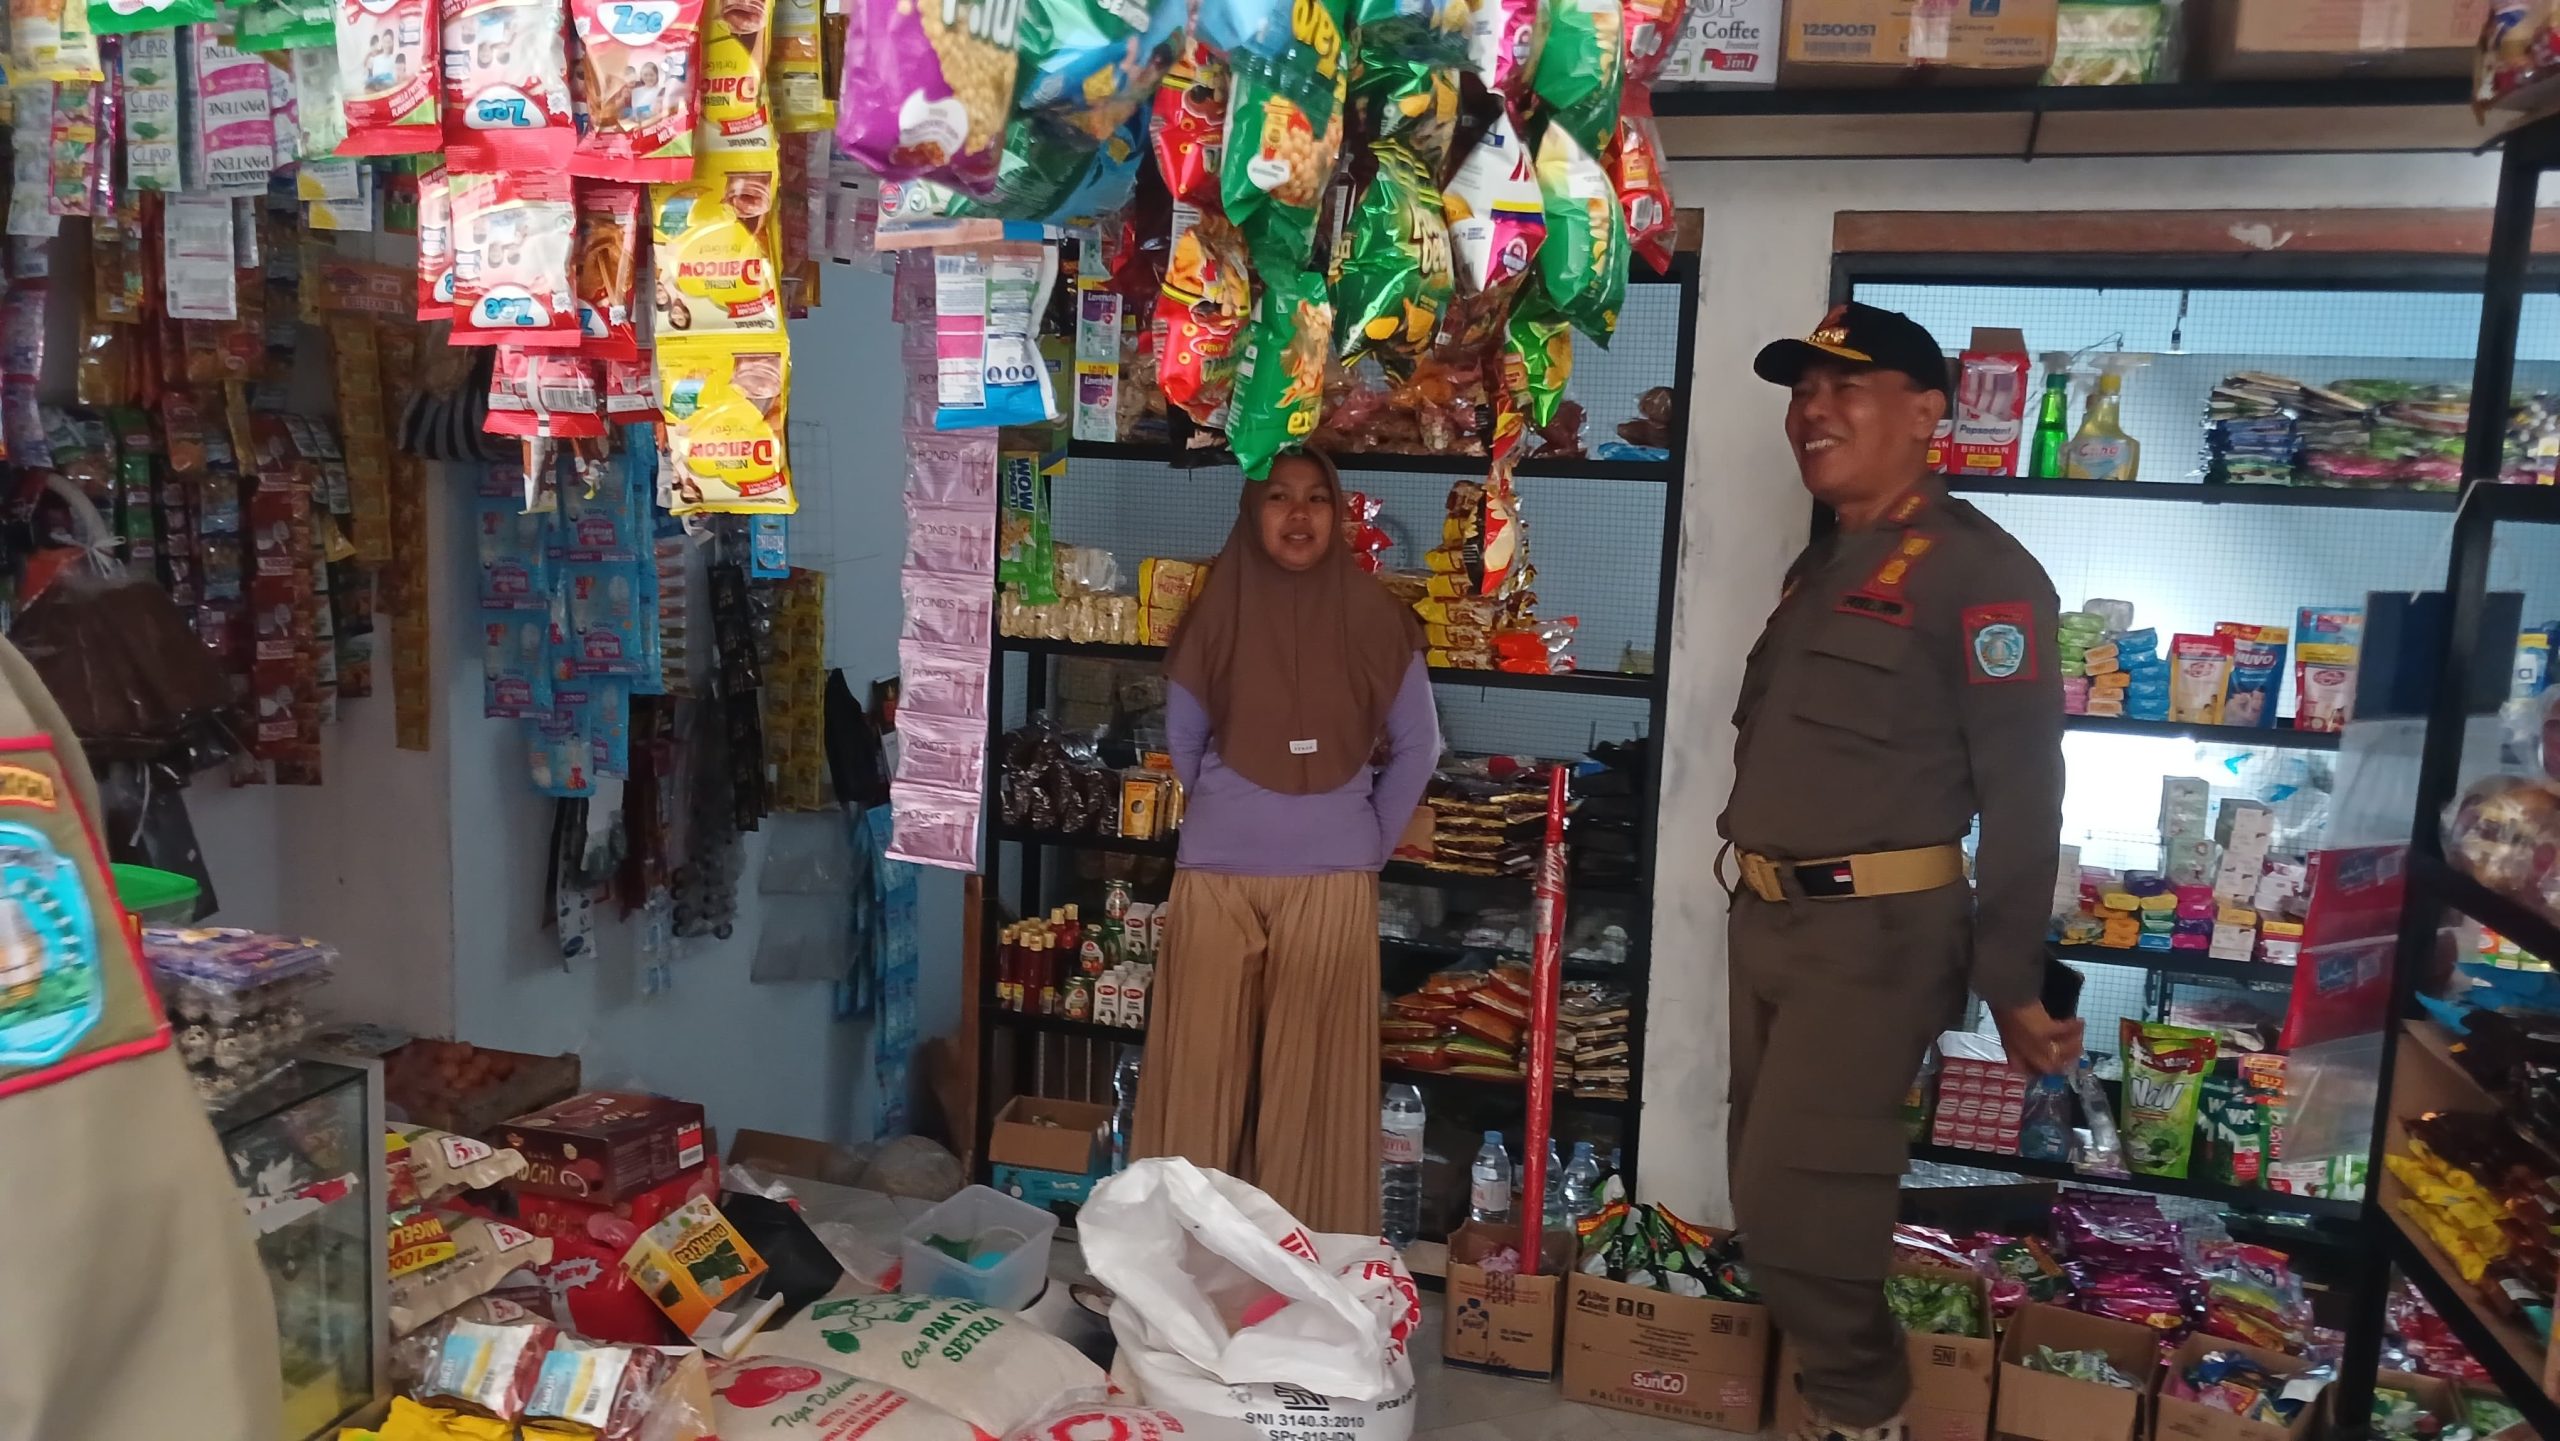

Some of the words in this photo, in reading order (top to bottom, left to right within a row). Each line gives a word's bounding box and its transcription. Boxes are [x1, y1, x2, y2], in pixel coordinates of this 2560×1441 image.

[612, 5, 664, 35] Zee
[1702, 20, 1760, 39] Coffee
[1803, 23, 1877, 37] 1250051
[128, 38, 168, 54] CLEAR
[131, 91, 169, 109] CLEAR
[208, 99, 267, 115] PANTENE
[476, 98, 531, 127] Zee
[132, 145, 172, 163] CLEAR
[211, 154, 272, 171] PANTENE
[678, 259, 761, 286] Dancow
[484, 297, 535, 326] Zee
[688, 439, 773, 466] Dancow
[1960, 446, 2009, 455] BRILIAN
[1016, 457, 1035, 513] WOW
[516, 1162, 556, 1186] OCHI
[554, 1264, 592, 1283] NEW
[1711, 1315, 1733, 1333] SNI
[901, 1340, 931, 1370] Cap
[920, 1310, 961, 1342] PAK
[941, 1315, 1005, 1363] SETRA
[1932, 1347, 1957, 1365] SNI
[1632, 1373, 1682, 1393] SunCo
[1274, 1386, 1330, 1407] SNI
[771, 1403, 814, 1429] Tiga
[1244, 1411, 1274, 1426] SNI
[1279, 1412, 1365, 1429] 3140.3:2010
